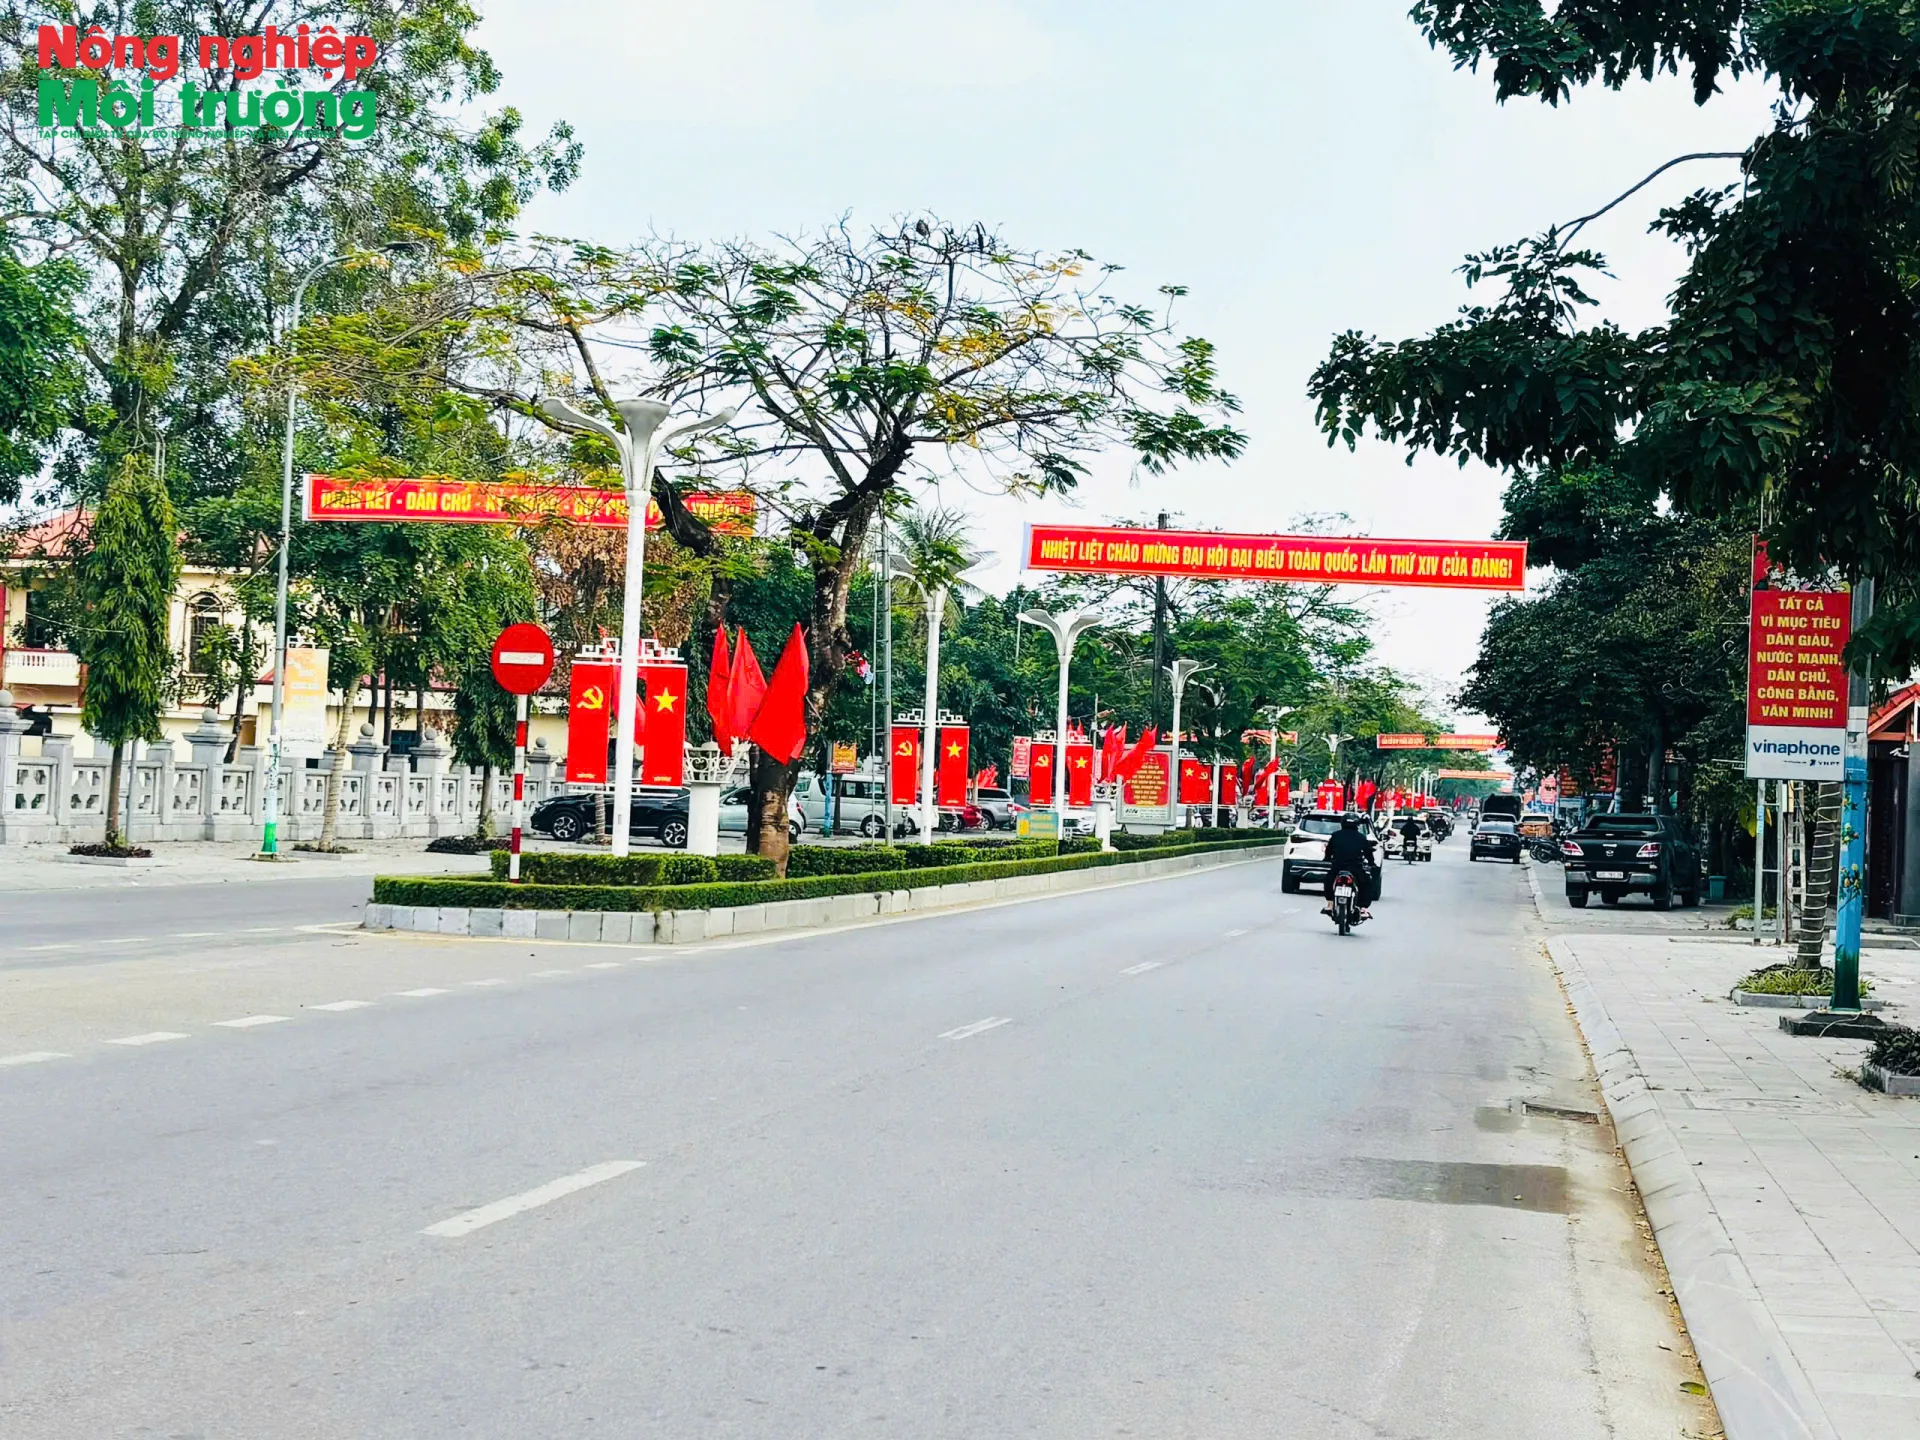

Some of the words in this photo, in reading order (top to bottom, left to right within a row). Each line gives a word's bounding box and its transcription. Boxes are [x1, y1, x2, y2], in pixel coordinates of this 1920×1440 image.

[406, 488, 438, 511] DÂN
[1041, 537, 1076, 563] NHIỆT
[1079, 538, 1104, 564] LIỆT
[1107, 540, 1138, 563] CHÀO
[1143, 541, 1179, 565] MỪNG
[1183, 546, 1203, 569] ĐẠI
[1207, 544, 1227, 570] HỘI
[1231, 548, 1251, 571] ĐẠI
[1256, 542, 1284, 570] BIỂU
[1288, 548, 1321, 571] TOÀN
[1324, 546, 1358, 573] QUỐC
[1390, 552, 1416, 575] THỨ
[1417, 556, 1440, 576] XIV
[1442, 551, 1468, 577] CỦA
[1472, 552, 1513, 579] ĐẢNG!
[1778, 595, 1802, 610] TẤT
[1806, 596, 1824, 611] CẢ
[1760, 614, 1774, 627] VÌ
[1777, 617, 1808, 630] MỤC
[1811, 616, 1840, 629] TIÊU
[1766, 632, 1794, 646] DÂN
[1757, 650, 1794, 664] NƯỚC
[1798, 653, 1842, 667] MẠNH,
[1767, 668, 1796, 682] DÂN
[1757, 686, 1794, 700] CÔNG
[1761, 704, 1789, 718] VĂN
[1792, 706, 1834, 720] MINH!
[1753, 739, 1841, 756] vinaphone
